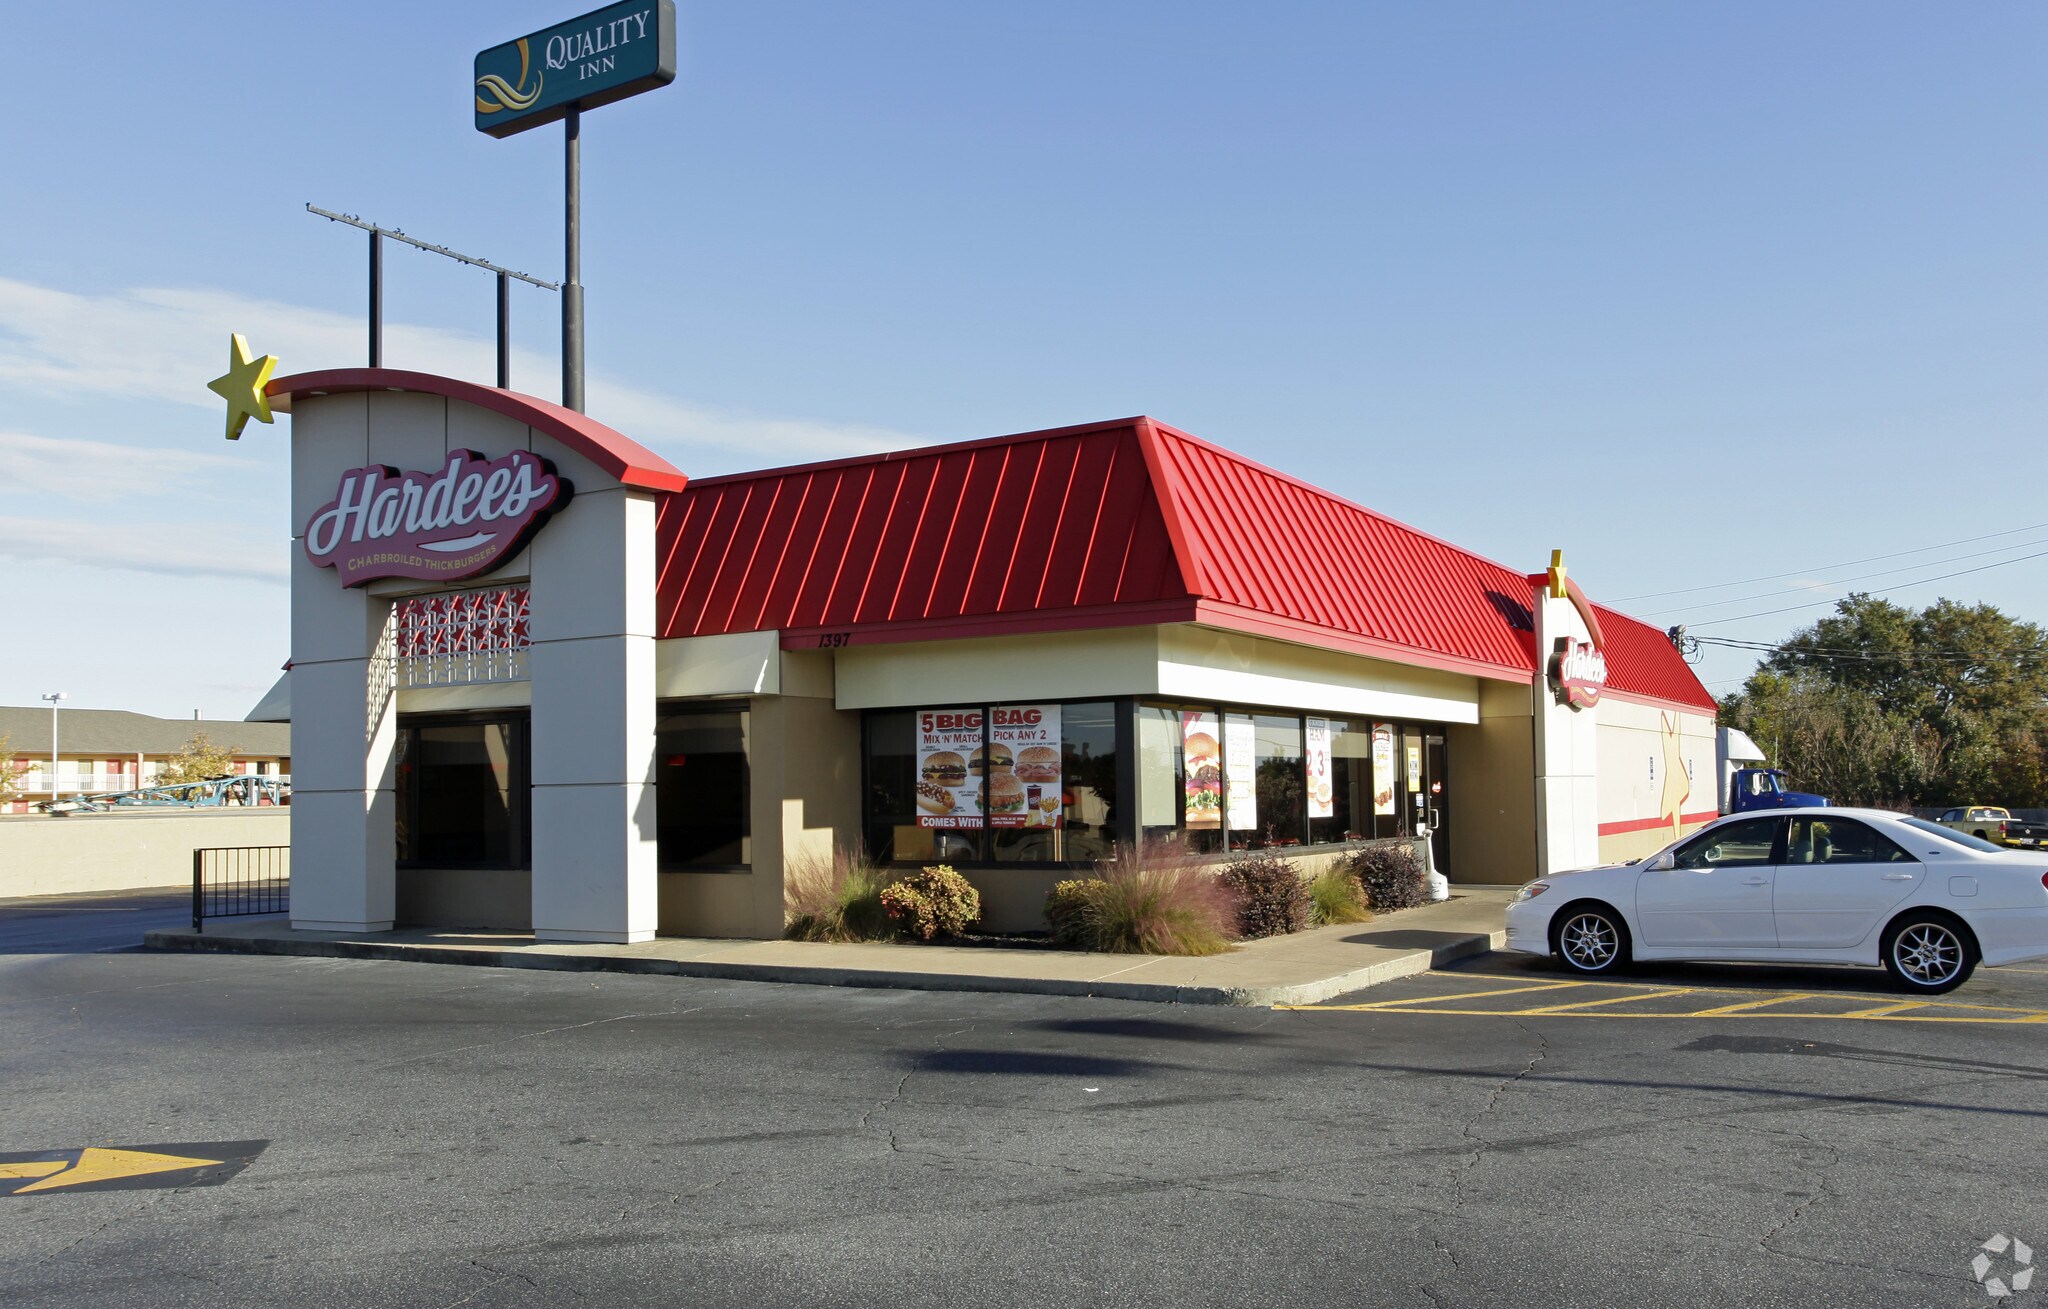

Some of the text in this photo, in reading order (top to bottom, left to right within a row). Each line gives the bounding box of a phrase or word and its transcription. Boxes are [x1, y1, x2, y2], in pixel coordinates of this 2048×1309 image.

[546, 10, 650, 70] QUALITY
[579, 55, 616, 80] INN
[307, 454, 549, 556] Hardee's
[348, 544, 497, 571] CHARBROILED THICKBURGERS
[818, 633, 851, 648] 1397
[936, 713, 983, 729] BIG
[992, 709, 1042, 726] BAG
[923, 734, 941, 744] MIX
[953, 733, 983, 744] MATCH
[993, 730, 1014, 741] PICK
[1017, 730, 1037, 740] ANY
[1040, 730, 1047, 740] 2
[921, 817, 956, 828] COMES
[958, 817, 983, 828] WITH
